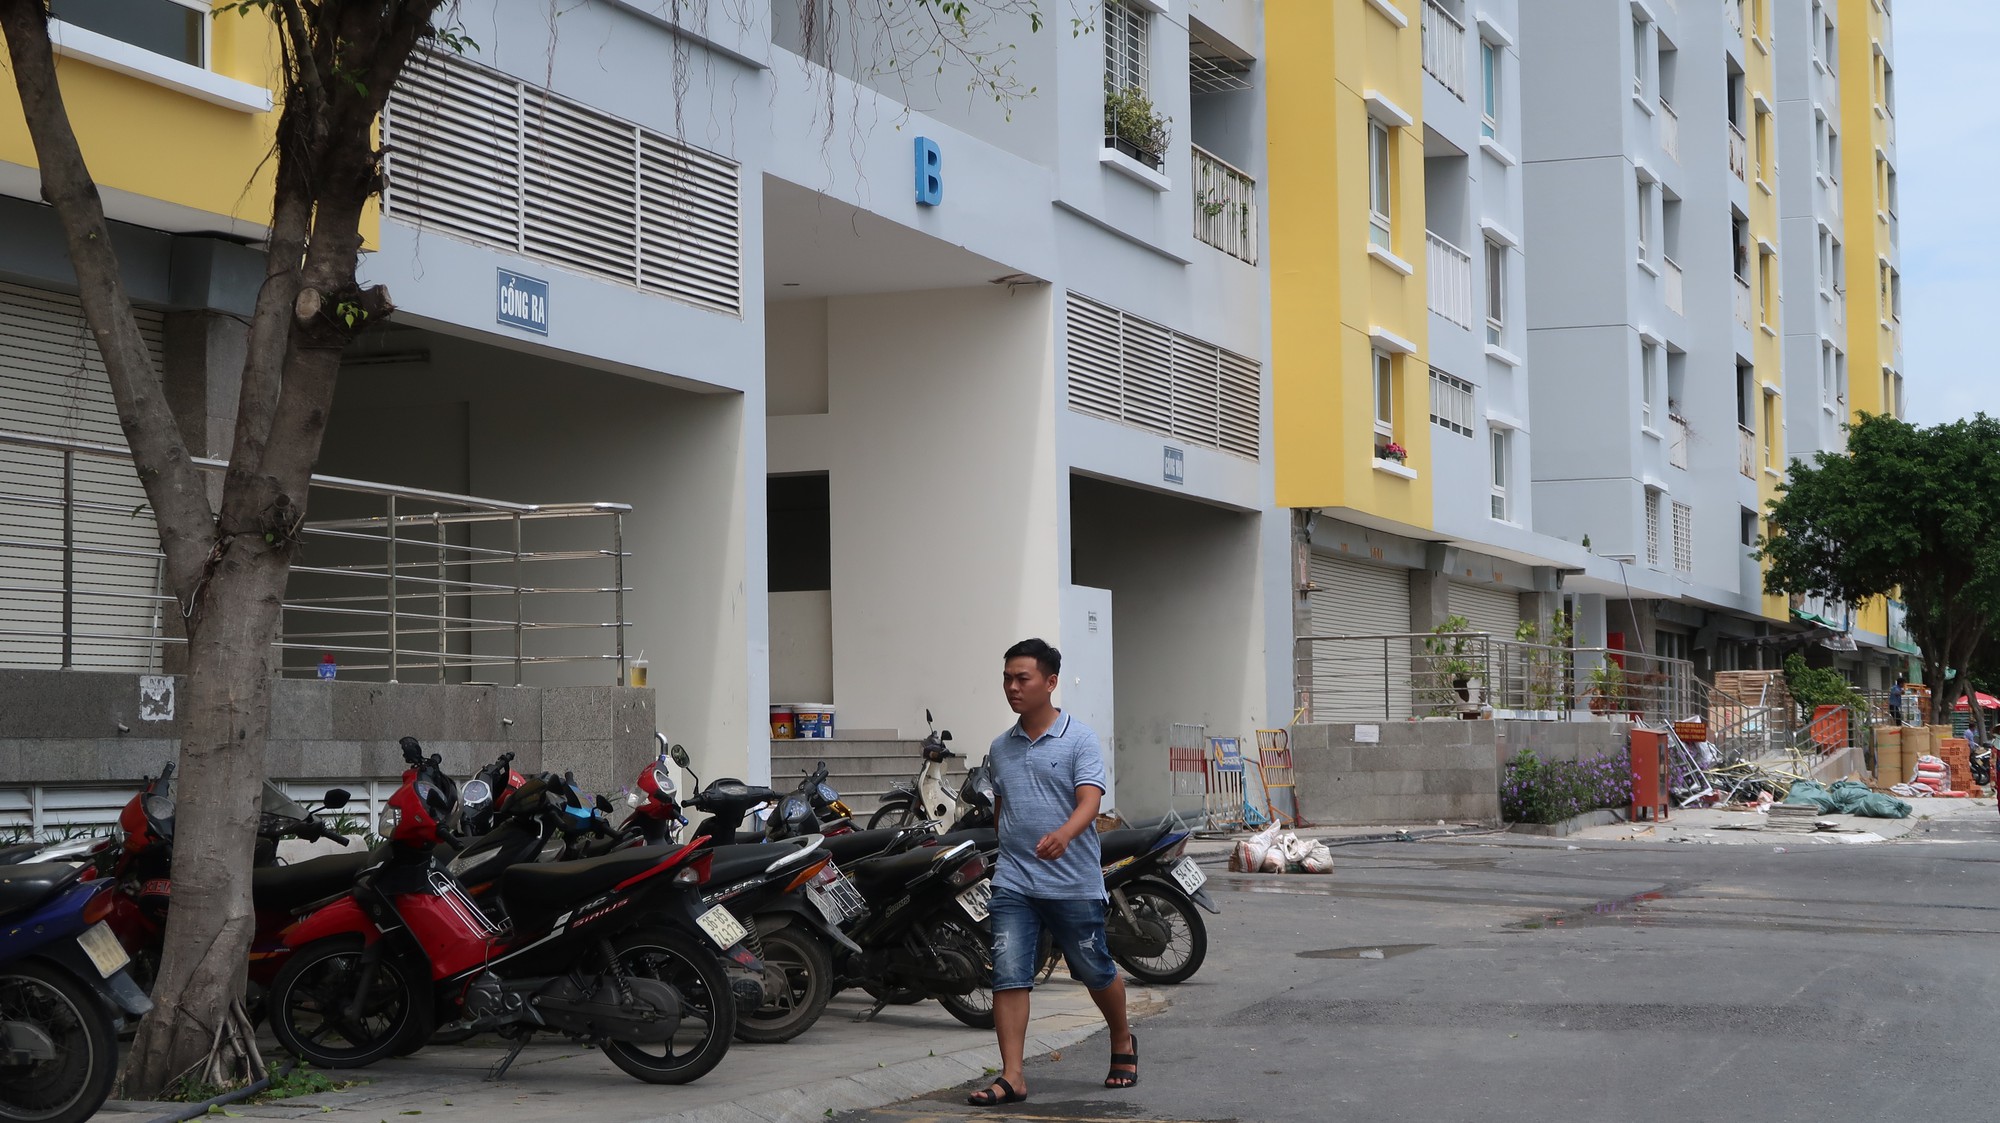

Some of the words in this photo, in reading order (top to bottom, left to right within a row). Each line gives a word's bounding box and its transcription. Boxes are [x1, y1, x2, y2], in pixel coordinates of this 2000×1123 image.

[914, 136, 943, 206] B
[501, 277, 529, 320] CỔNG
[531, 294, 545, 325] RA
[1185, 871, 1203, 890] 9497
